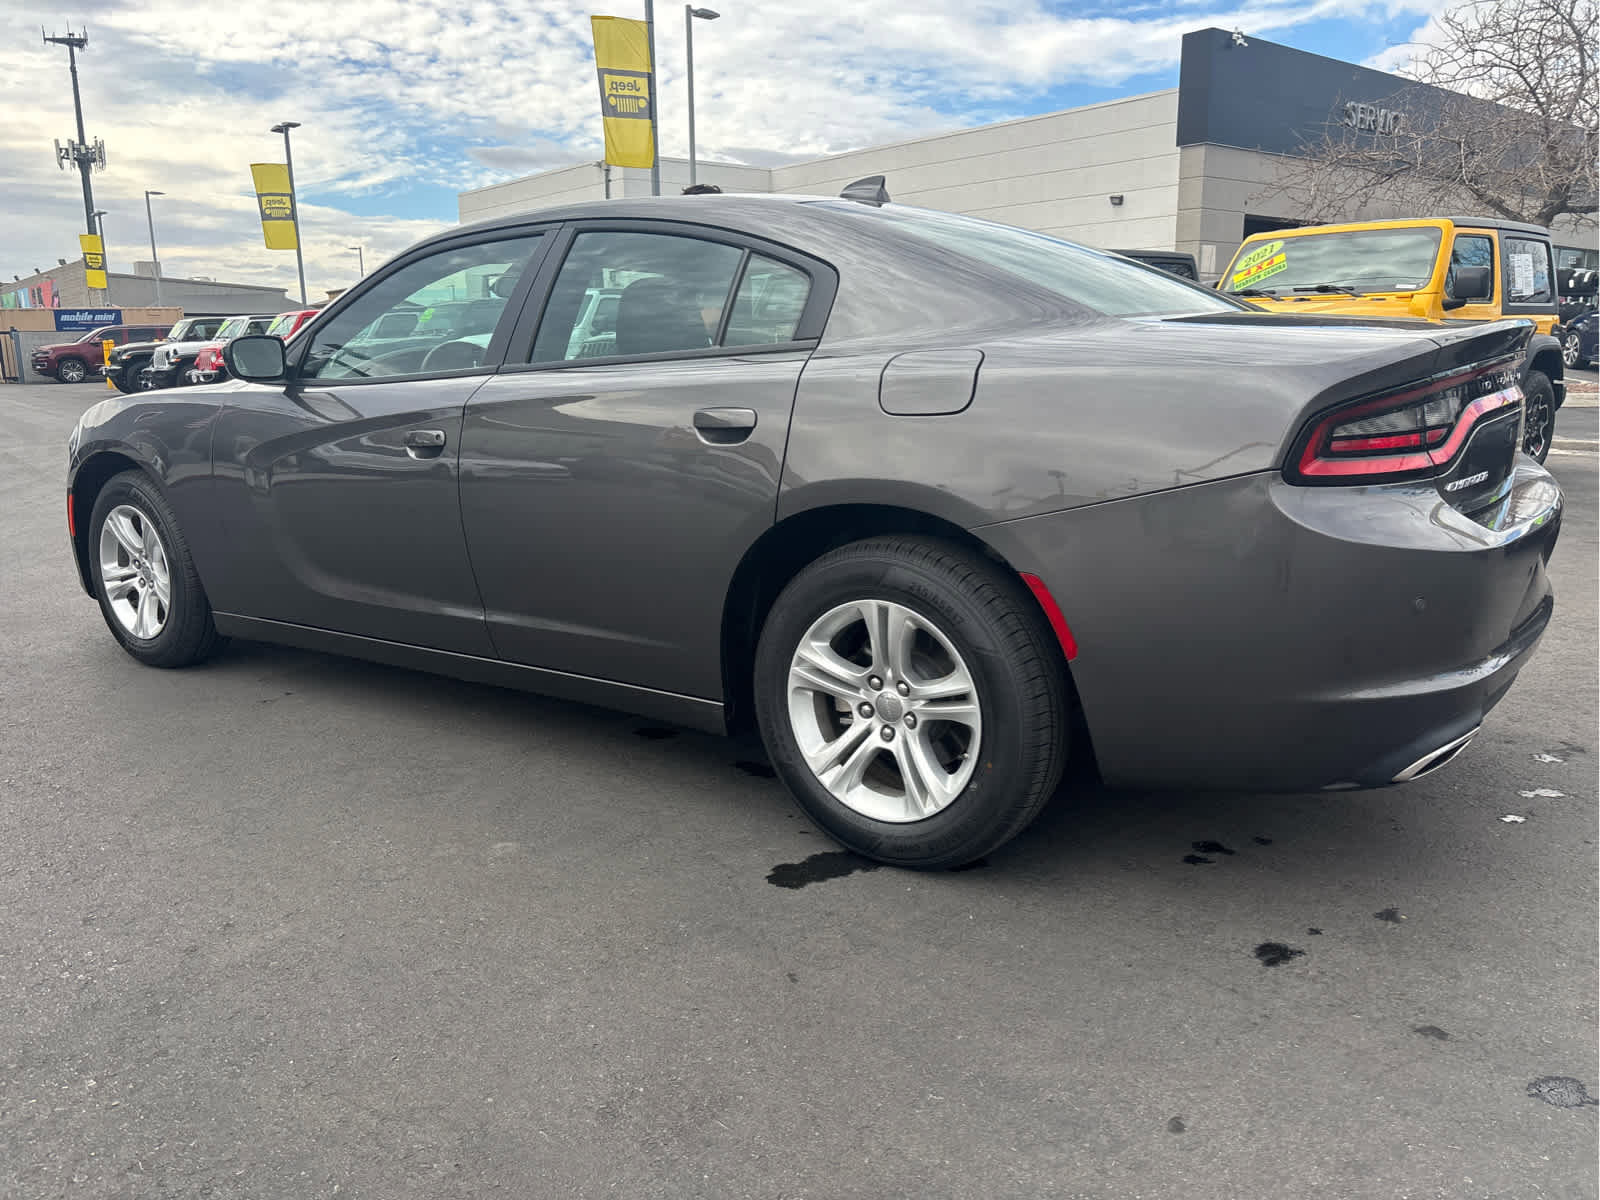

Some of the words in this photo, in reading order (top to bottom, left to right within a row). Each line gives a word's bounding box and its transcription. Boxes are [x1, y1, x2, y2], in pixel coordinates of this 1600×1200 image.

[1344, 101, 1408, 136] SERVIC
[1244, 243, 1274, 267] 2021
[60, 311, 93, 321] mobile
[94, 312, 116, 321] mini
